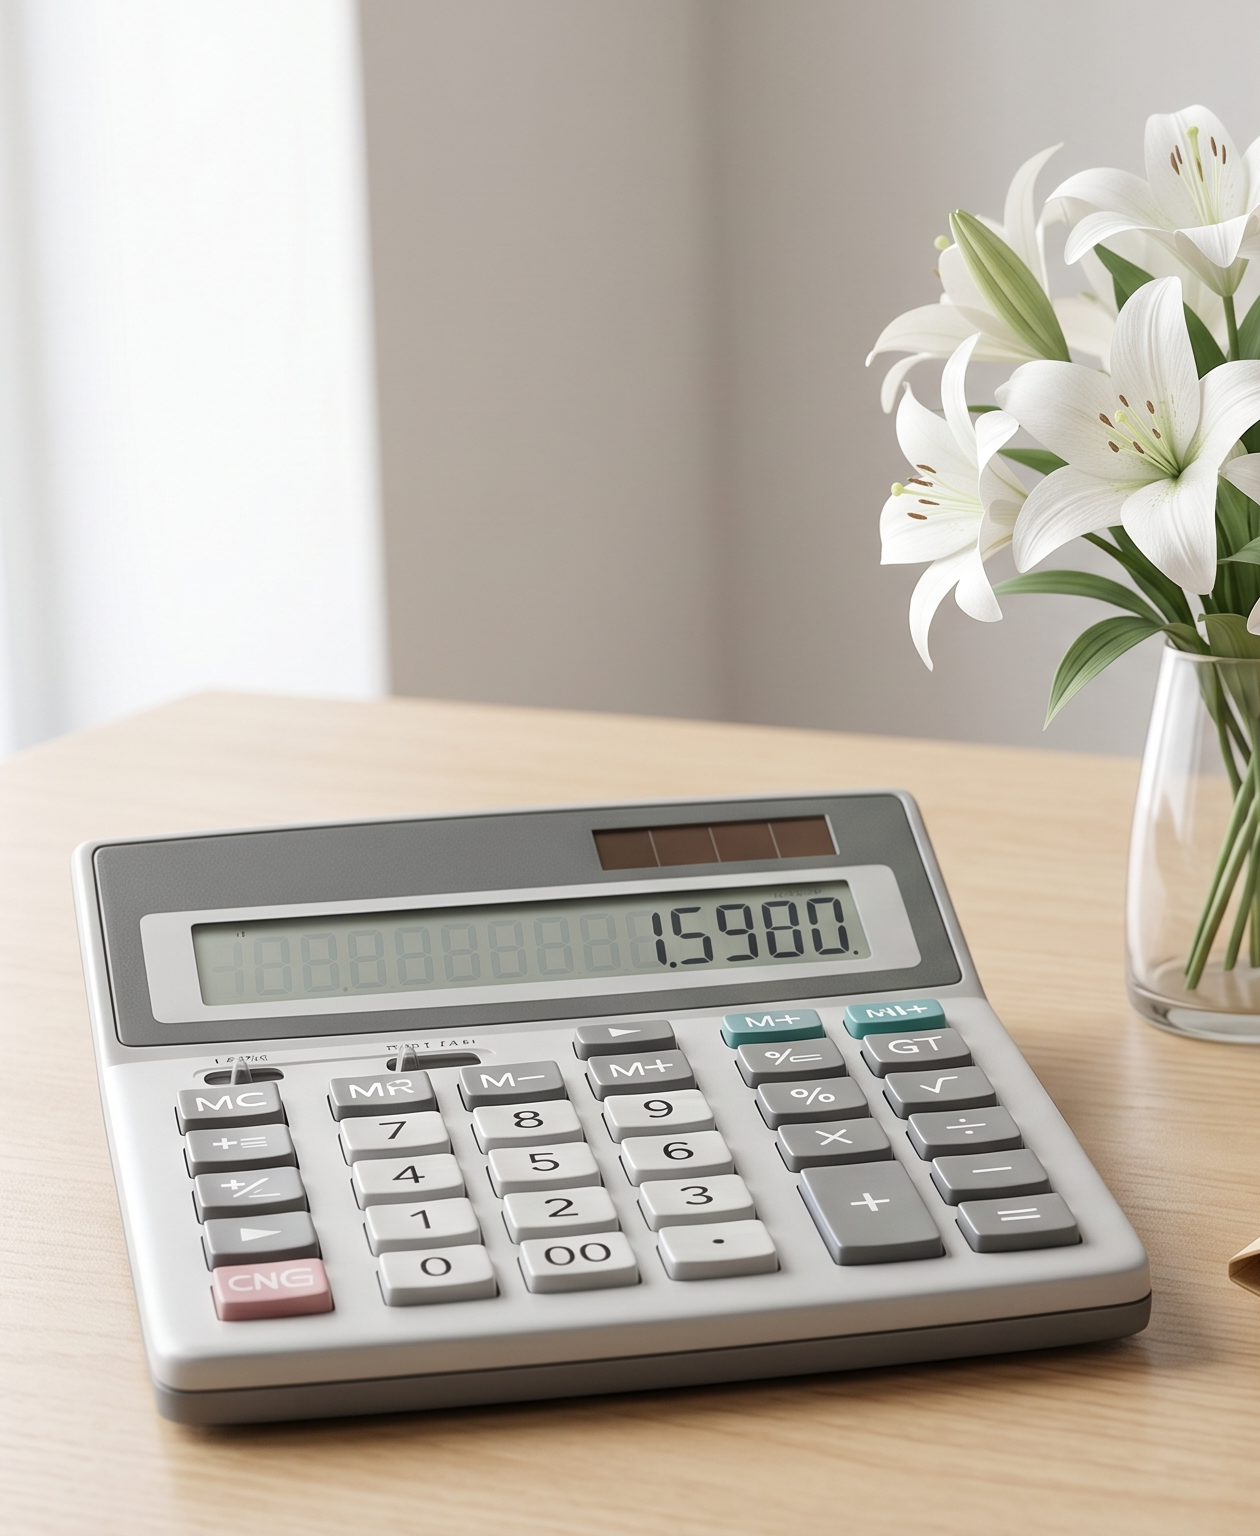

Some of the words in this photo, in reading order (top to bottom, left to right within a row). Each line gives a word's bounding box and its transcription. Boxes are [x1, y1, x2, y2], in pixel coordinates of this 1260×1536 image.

[746, 1015, 801, 1028] M+
[888, 1037, 942, 1054] GT
[609, 1059, 672, 1077] M+
[349, 1080, 415, 1099] MR
[196, 1092, 266, 1113] MC
[643, 1100, 673, 1118] 9
[514, 1110, 544, 1128] 8
[379, 1121, 407, 1139] 7
[662, 1142, 694, 1160] 6
[530, 1153, 559, 1171] 5
[392, 1165, 425, 1184] 4
[685, 1187, 713, 1205] 3
[544, 1198, 578, 1218] 2
[410, 1210, 431, 1230] 1
[545, 1242, 610, 1266] 00
[421, 1257, 451, 1276] 0
[228, 1268, 313, 1292] CNG
